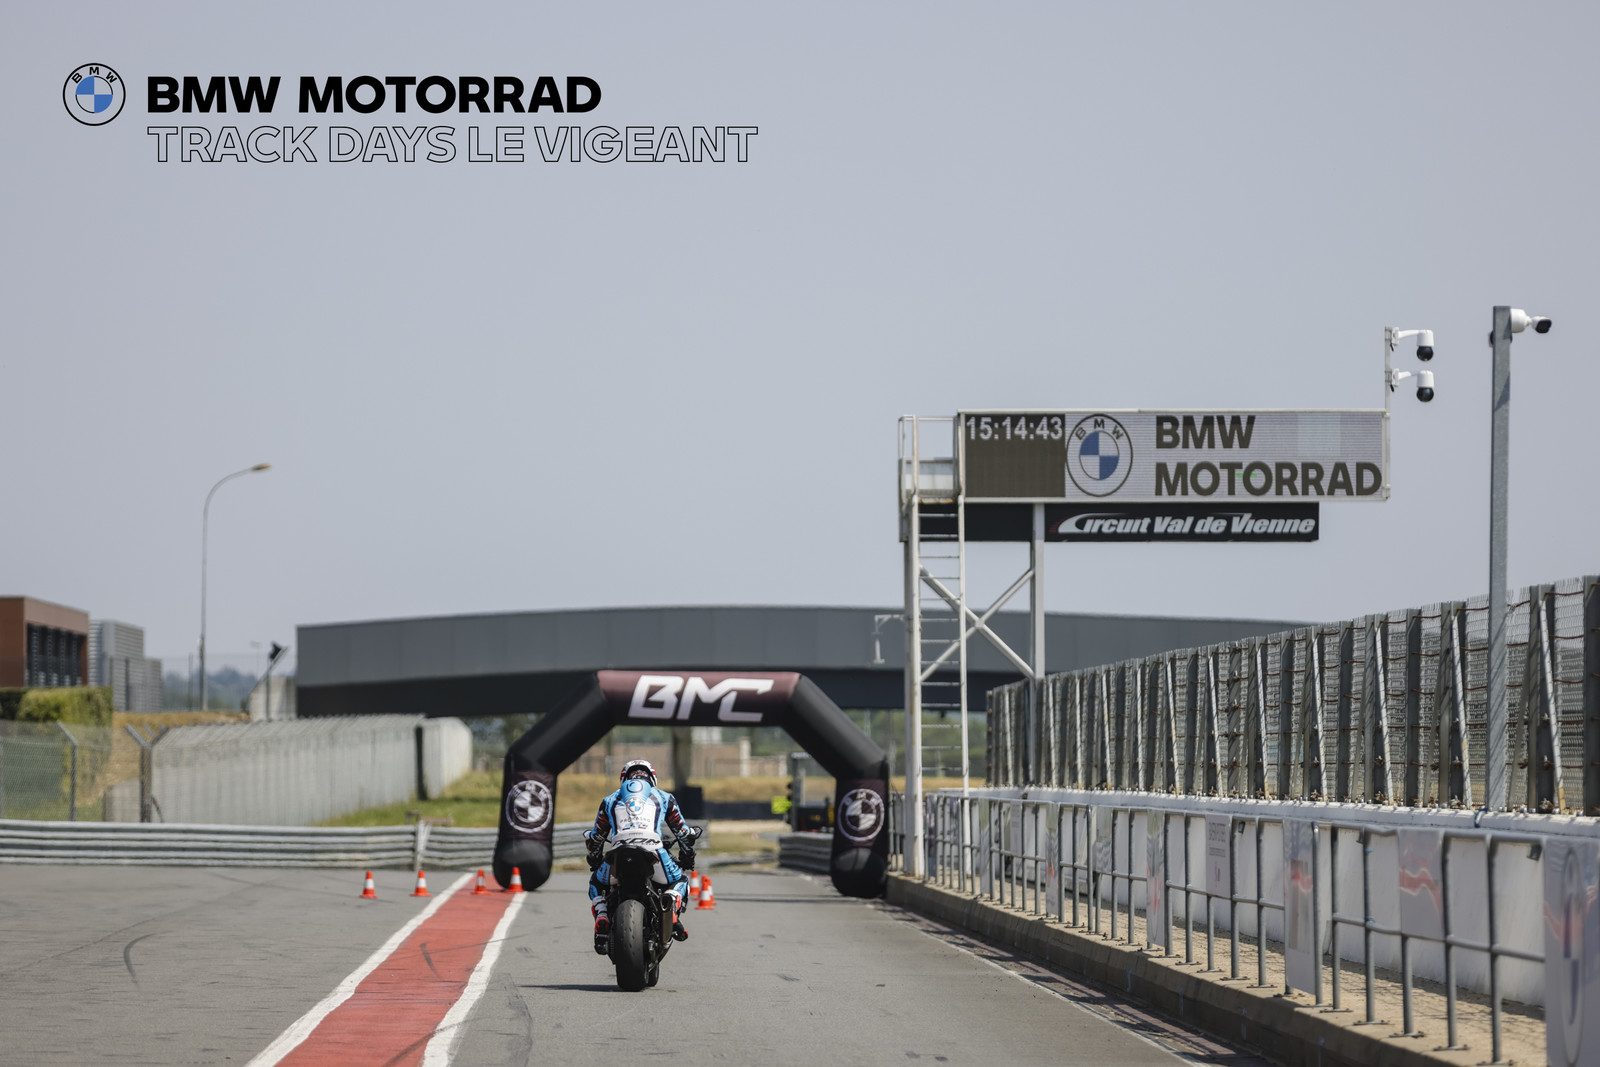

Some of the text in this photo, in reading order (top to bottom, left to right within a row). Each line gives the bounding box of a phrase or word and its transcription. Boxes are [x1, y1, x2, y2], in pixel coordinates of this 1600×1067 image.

[966, 416, 1063, 440] 15:14:43
[1155, 414, 1256, 449] BMW
[1155, 461, 1382, 497] MOTORRAD
[1056, 512, 1316, 534] Circuit Val de Vienne
[628, 674, 775, 722] BMC
